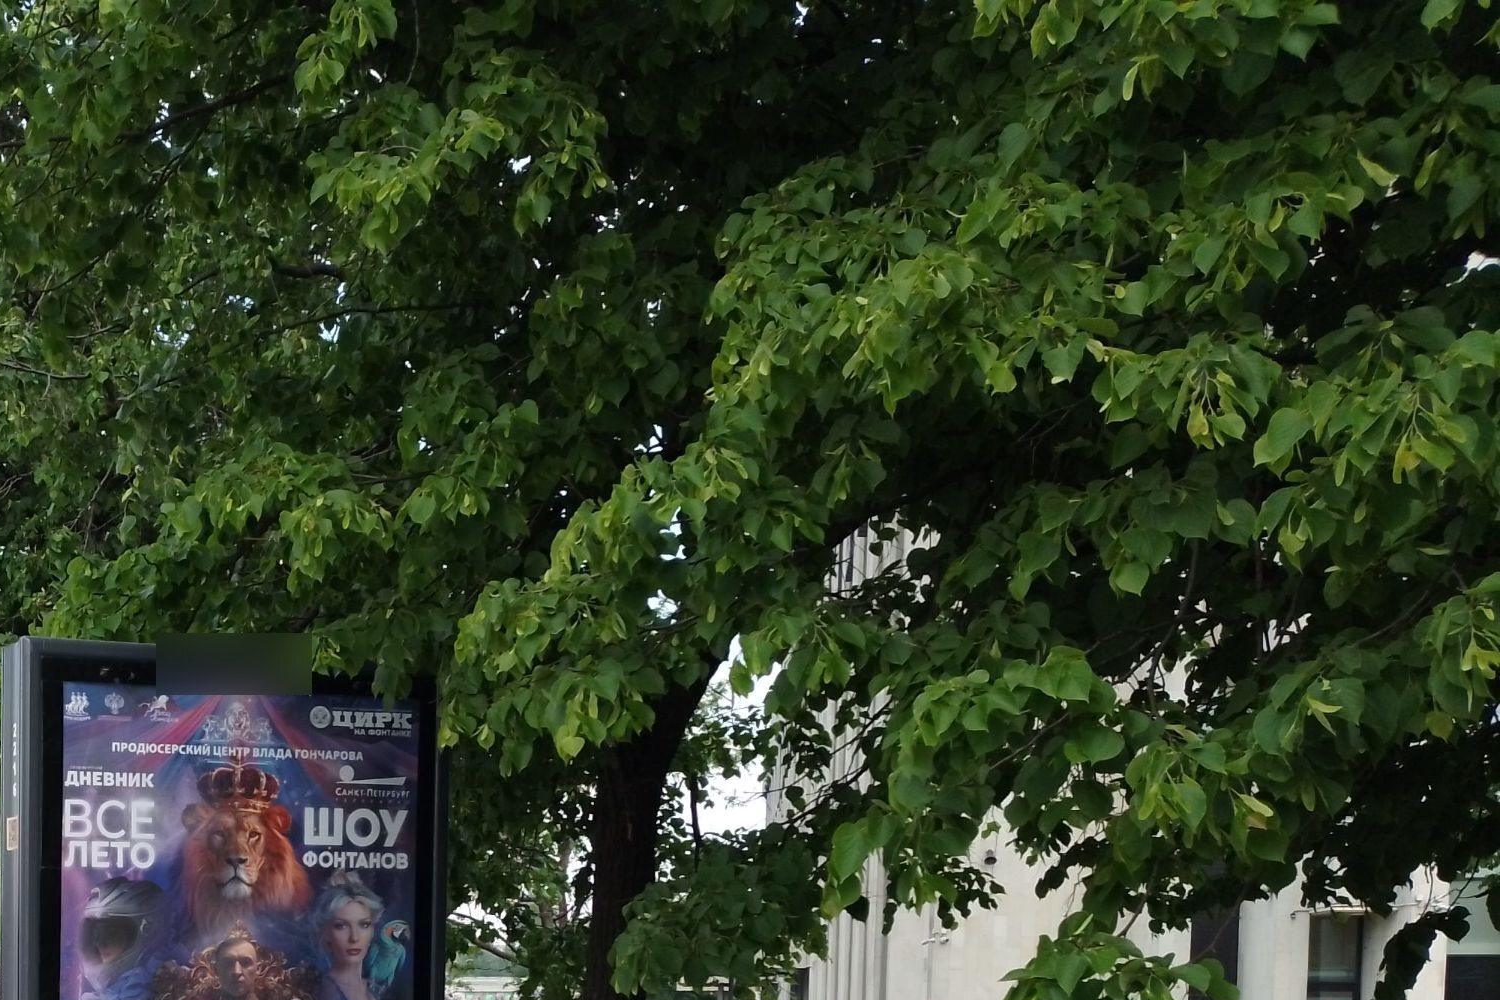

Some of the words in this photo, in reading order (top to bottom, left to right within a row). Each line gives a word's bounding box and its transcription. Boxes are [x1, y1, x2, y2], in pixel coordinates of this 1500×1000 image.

[332, 711, 412, 729] ЦИРК
[354, 728, 366, 736] НА
[111, 742, 211, 756] ПРОДЮСЕРСКИЙ
[213, 745, 250, 758] ЦЕНТР
[252, 748, 294, 760] ВЛАДА
[295, 749, 363, 761] ГОНЧАРОВА
[64, 770, 155, 788] ДНЕВНИК
[64, 798, 156, 839] ВСЕ
[304, 806, 409, 847] ШОУ
[64, 840, 156, 869] ЛЕТО
[302, 850, 409, 869] ФОНТАНОВ
